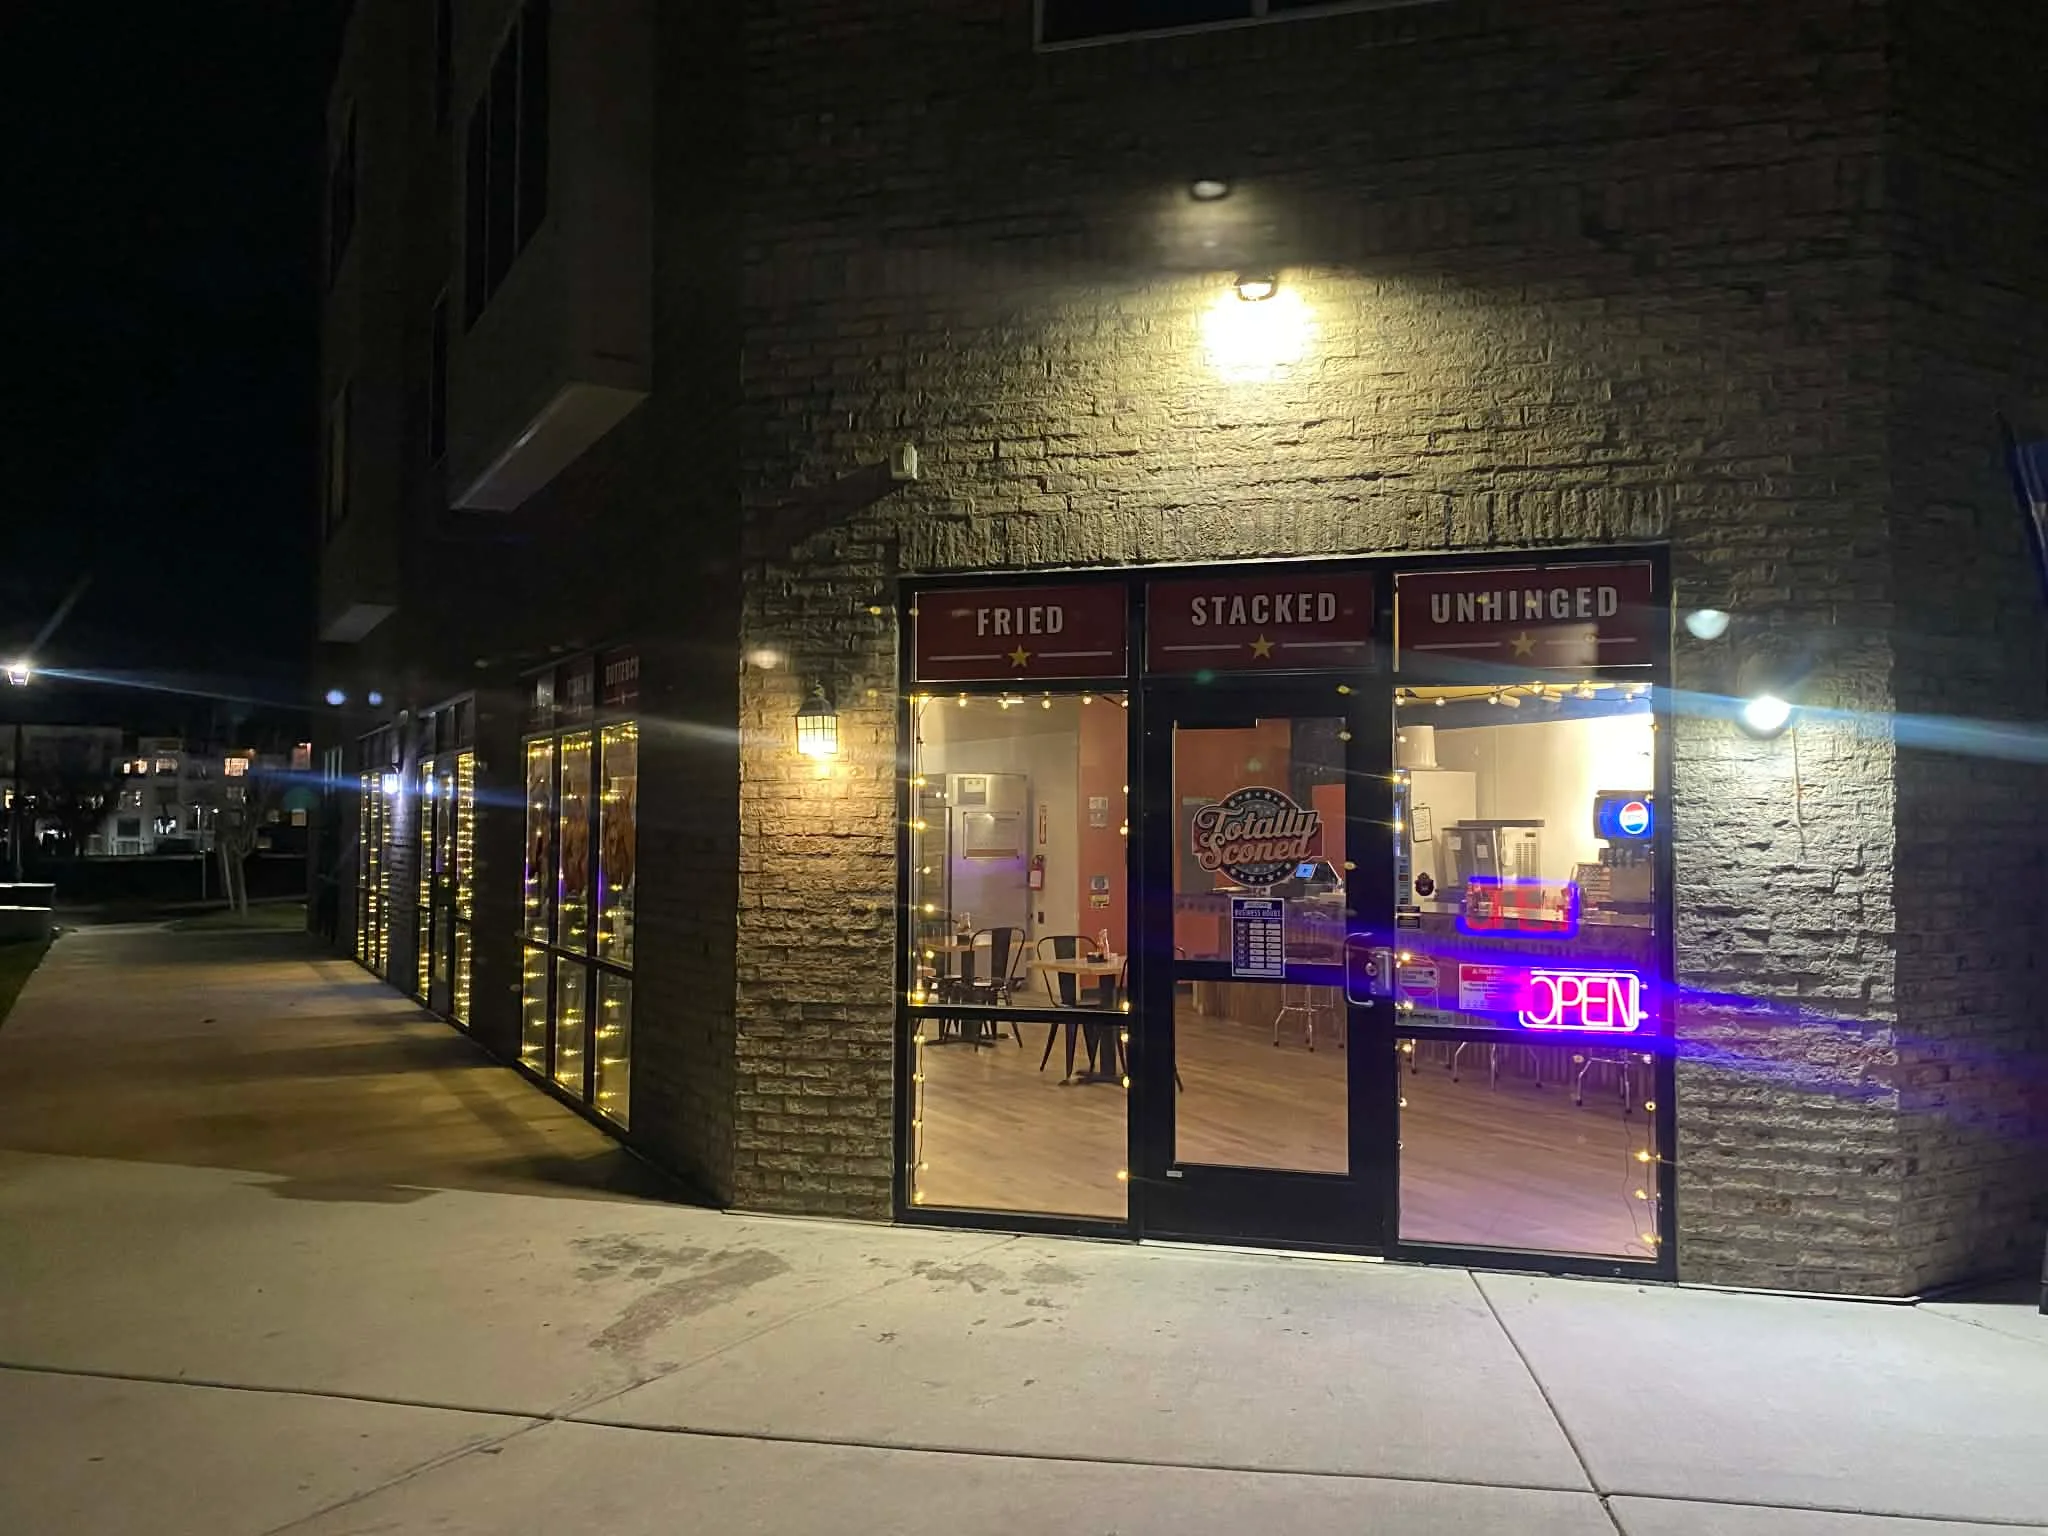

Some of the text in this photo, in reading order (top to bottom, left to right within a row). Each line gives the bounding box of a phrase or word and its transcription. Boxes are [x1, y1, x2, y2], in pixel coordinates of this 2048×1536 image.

[977, 606, 1063, 636] FRIED
[1191, 592, 1336, 626] STACKED
[1431, 586, 1618, 624] UNHINGED
[1196, 807, 1318, 843] Totally
[1200, 833, 1312, 870] Sconed
[1527, 976, 1637, 1027] OPEN
